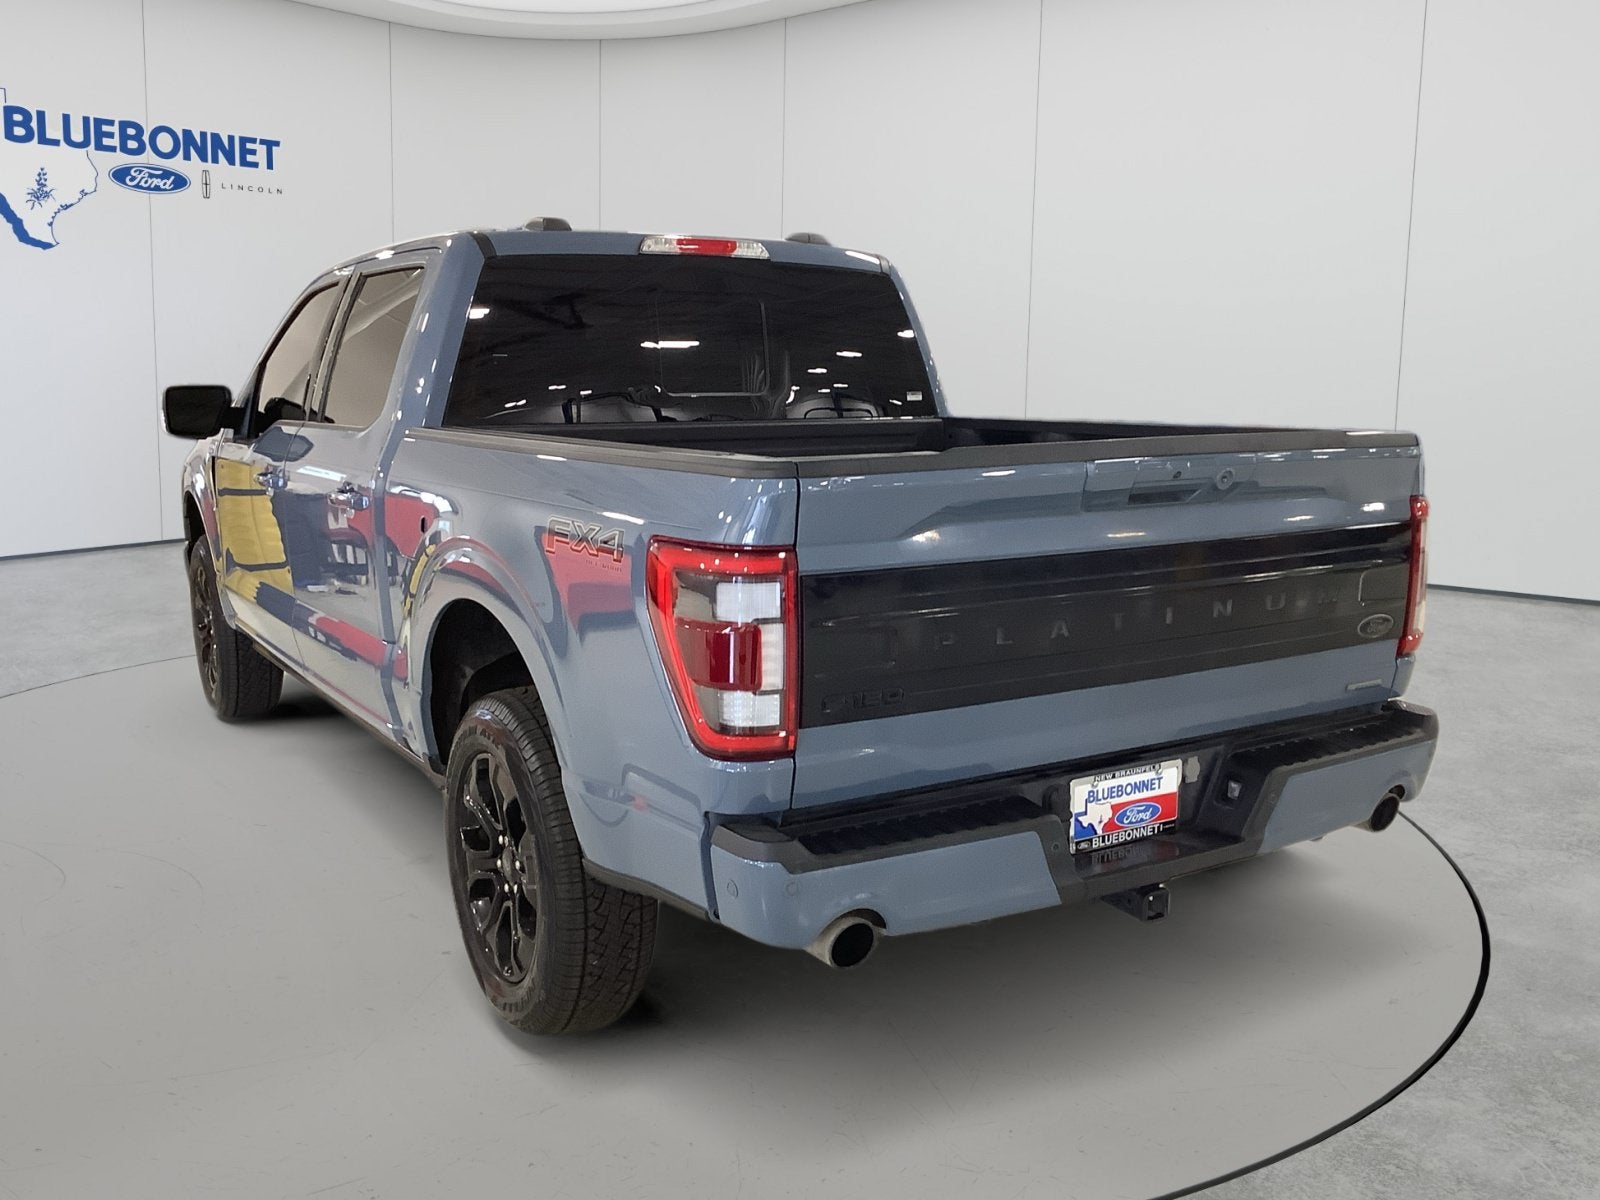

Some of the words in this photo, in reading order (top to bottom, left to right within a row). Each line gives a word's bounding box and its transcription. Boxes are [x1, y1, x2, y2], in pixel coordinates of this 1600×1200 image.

[3, 105, 281, 171] BLUEBONNET
[125, 166, 175, 191] Ford
[221, 182, 283, 195] LINCOLN
[545, 515, 625, 563] FX4
[1087, 777, 1163, 803] BLUEBONNET
[1123, 804, 1153, 824] Ford
[1092, 824, 1159, 848] BLUEBONNET
